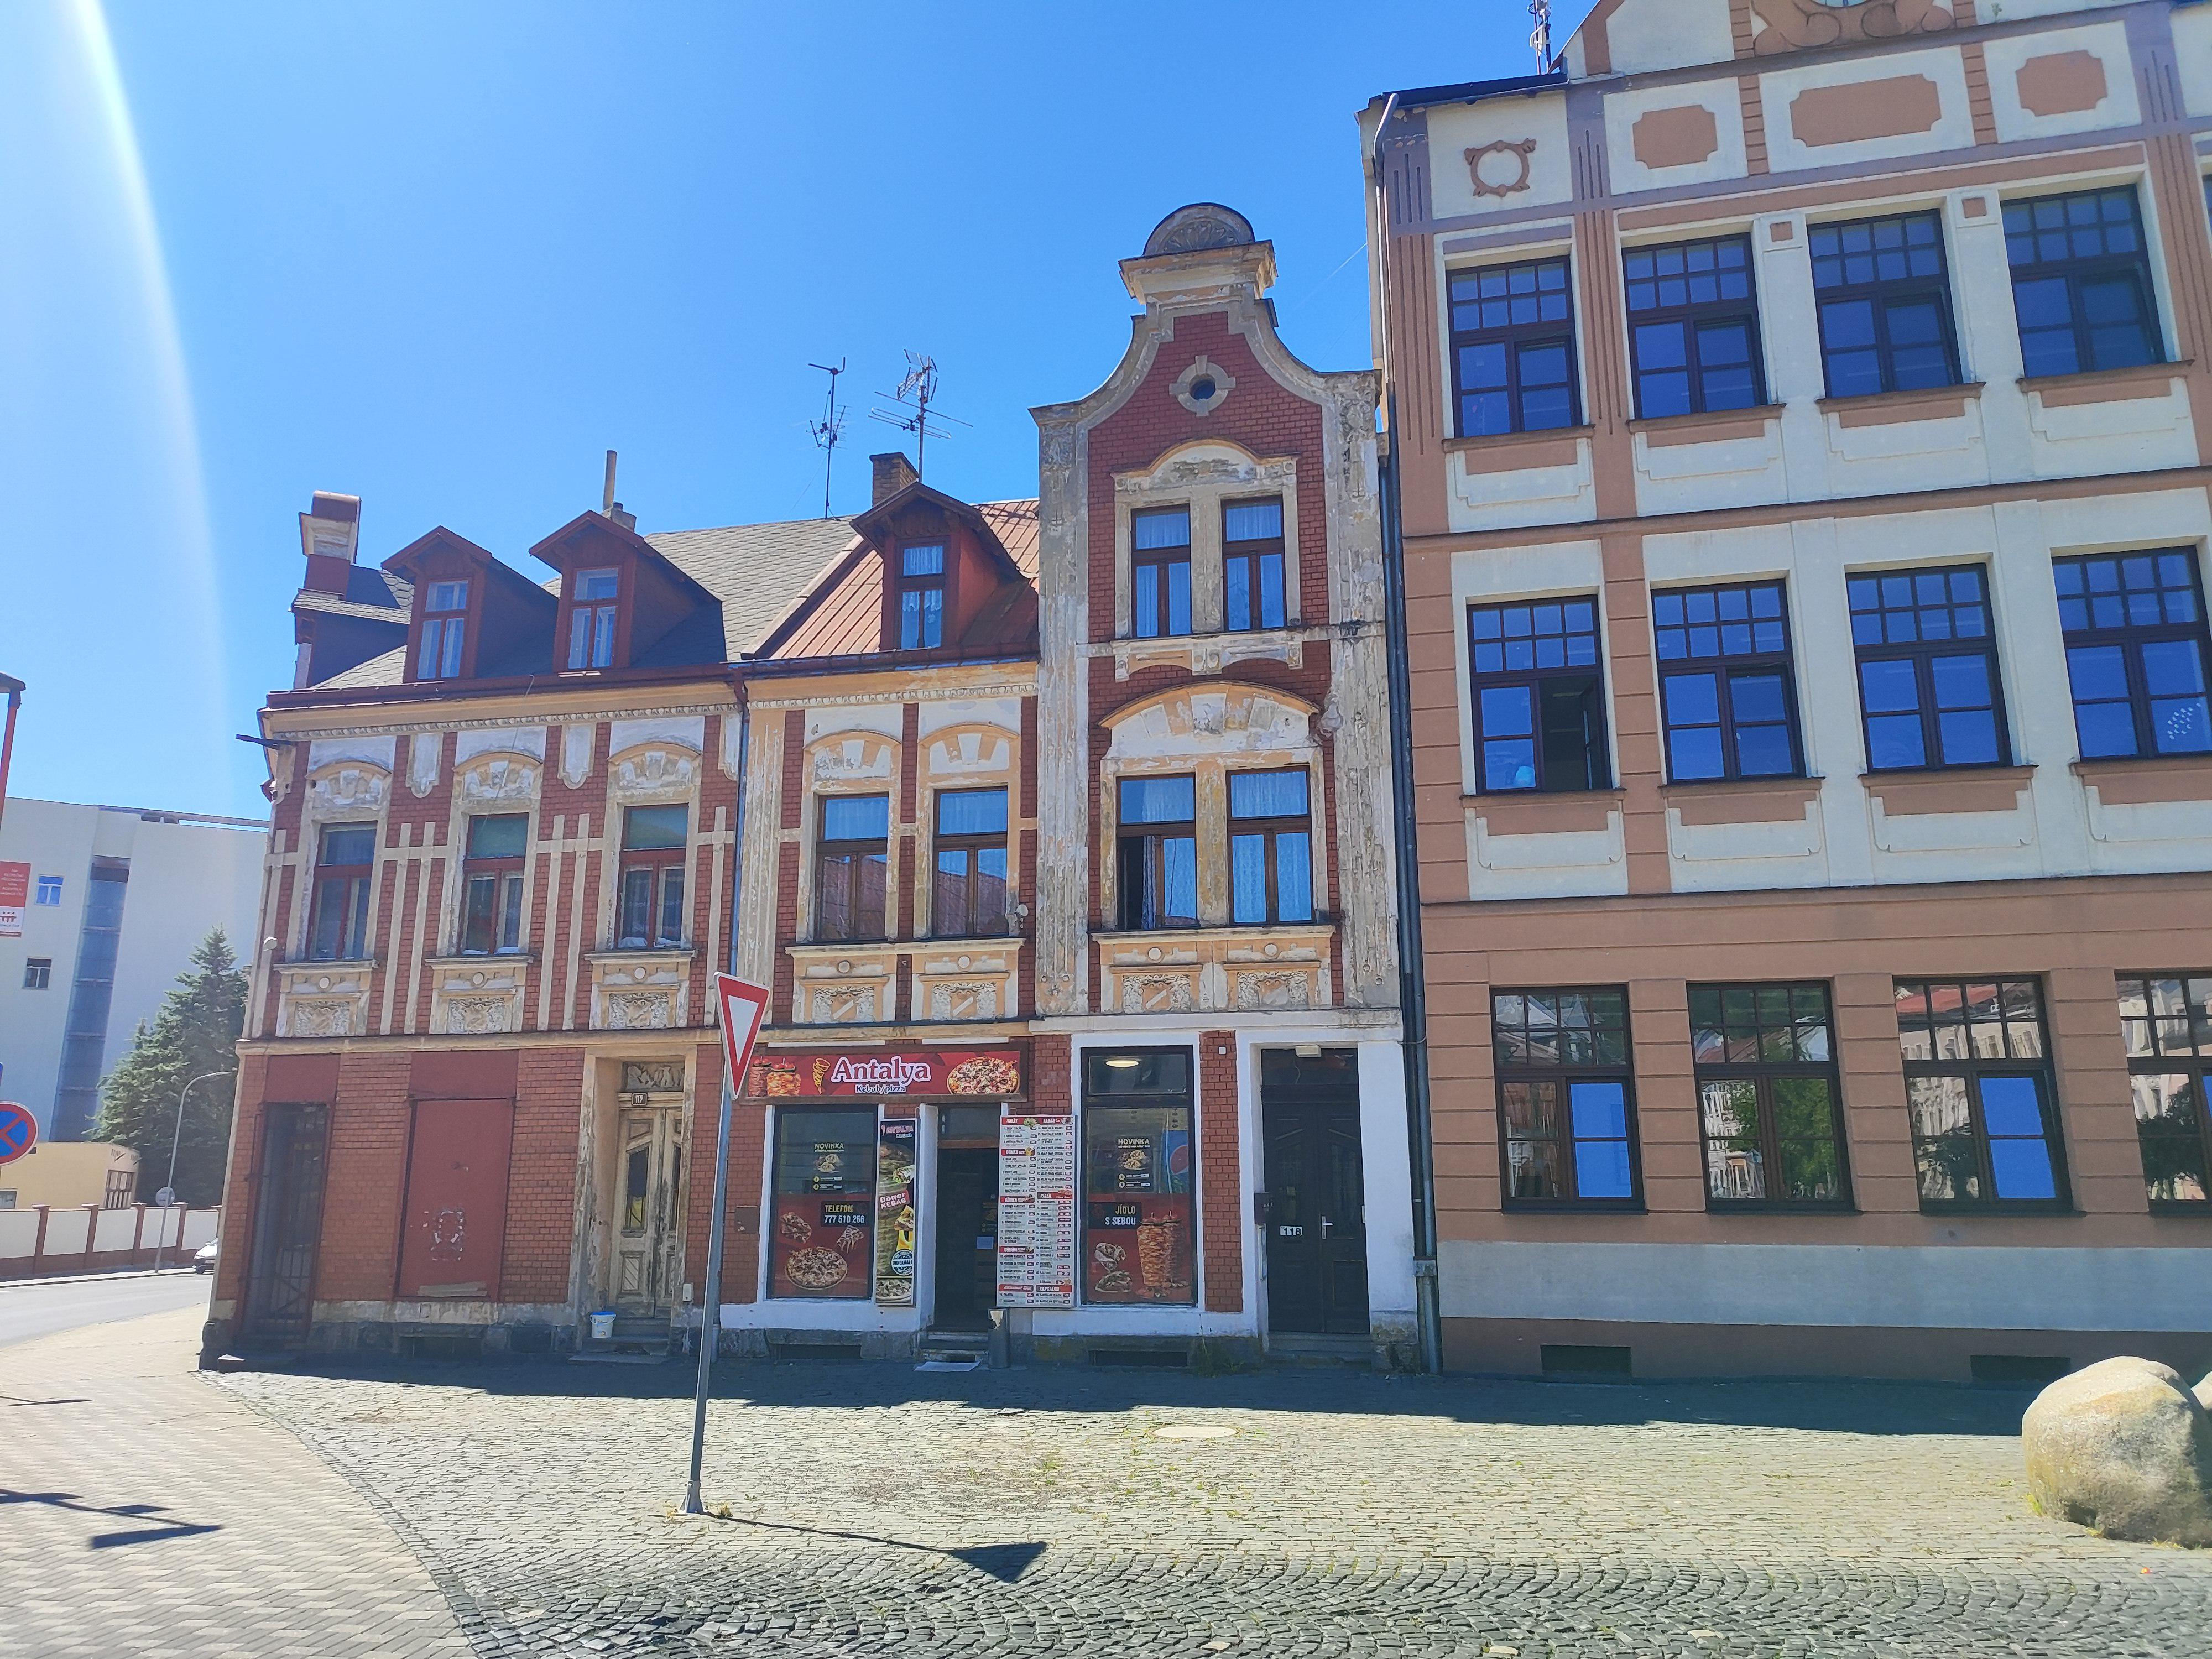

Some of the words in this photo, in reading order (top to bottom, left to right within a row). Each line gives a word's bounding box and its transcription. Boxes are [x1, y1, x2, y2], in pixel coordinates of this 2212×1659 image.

[832, 1056, 931, 1086] Antalya
[855, 1084, 906, 1094] Kebab/pizza
[880, 1193, 906, 1203] Döner
[825, 1204, 853, 1213] TELEFON
[881, 1198, 907, 1209] KEBAB
[1115, 1204, 1136, 1214] JÍDLO
[1105, 1217, 1110, 1225] S
[1112, 1217, 1136, 1225] SEBOU
[1284, 1227, 1301, 1235] 118
